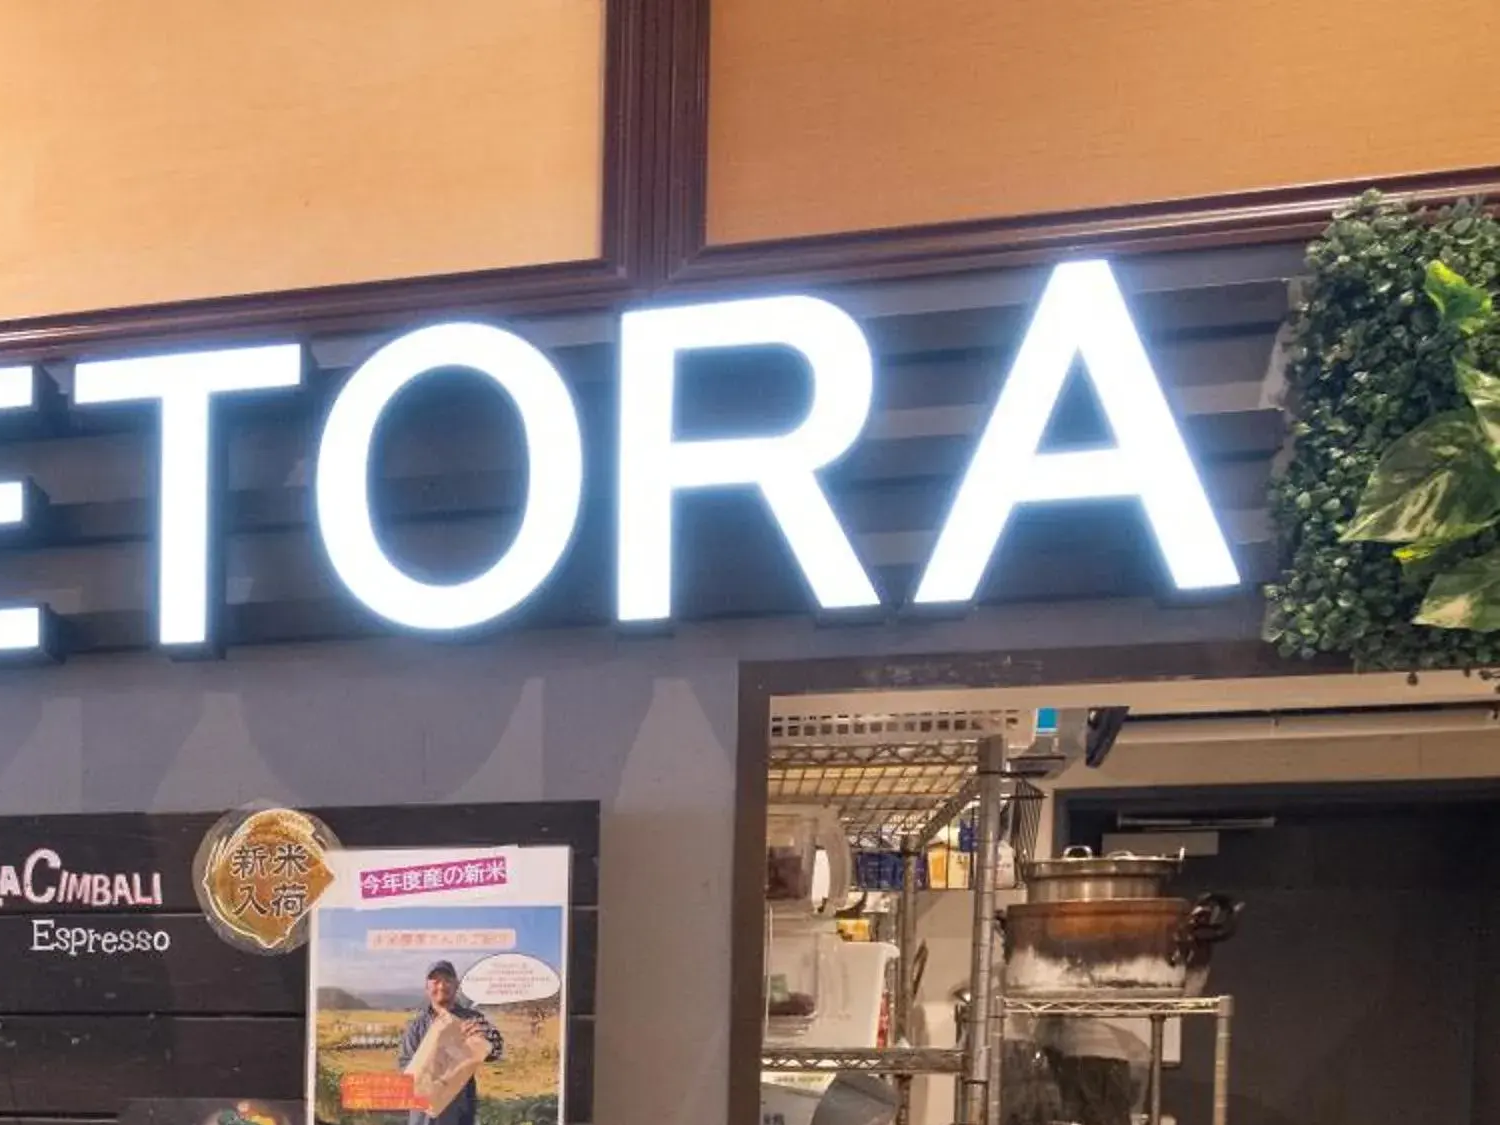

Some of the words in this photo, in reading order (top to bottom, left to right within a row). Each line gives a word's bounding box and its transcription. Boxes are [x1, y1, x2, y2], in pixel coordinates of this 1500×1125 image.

[231, 843, 309, 879] 新米
[362, 861, 506, 896] 今年度産の新米
[232, 882, 308, 917] 入荷
[30, 919, 170, 956] Espresso
